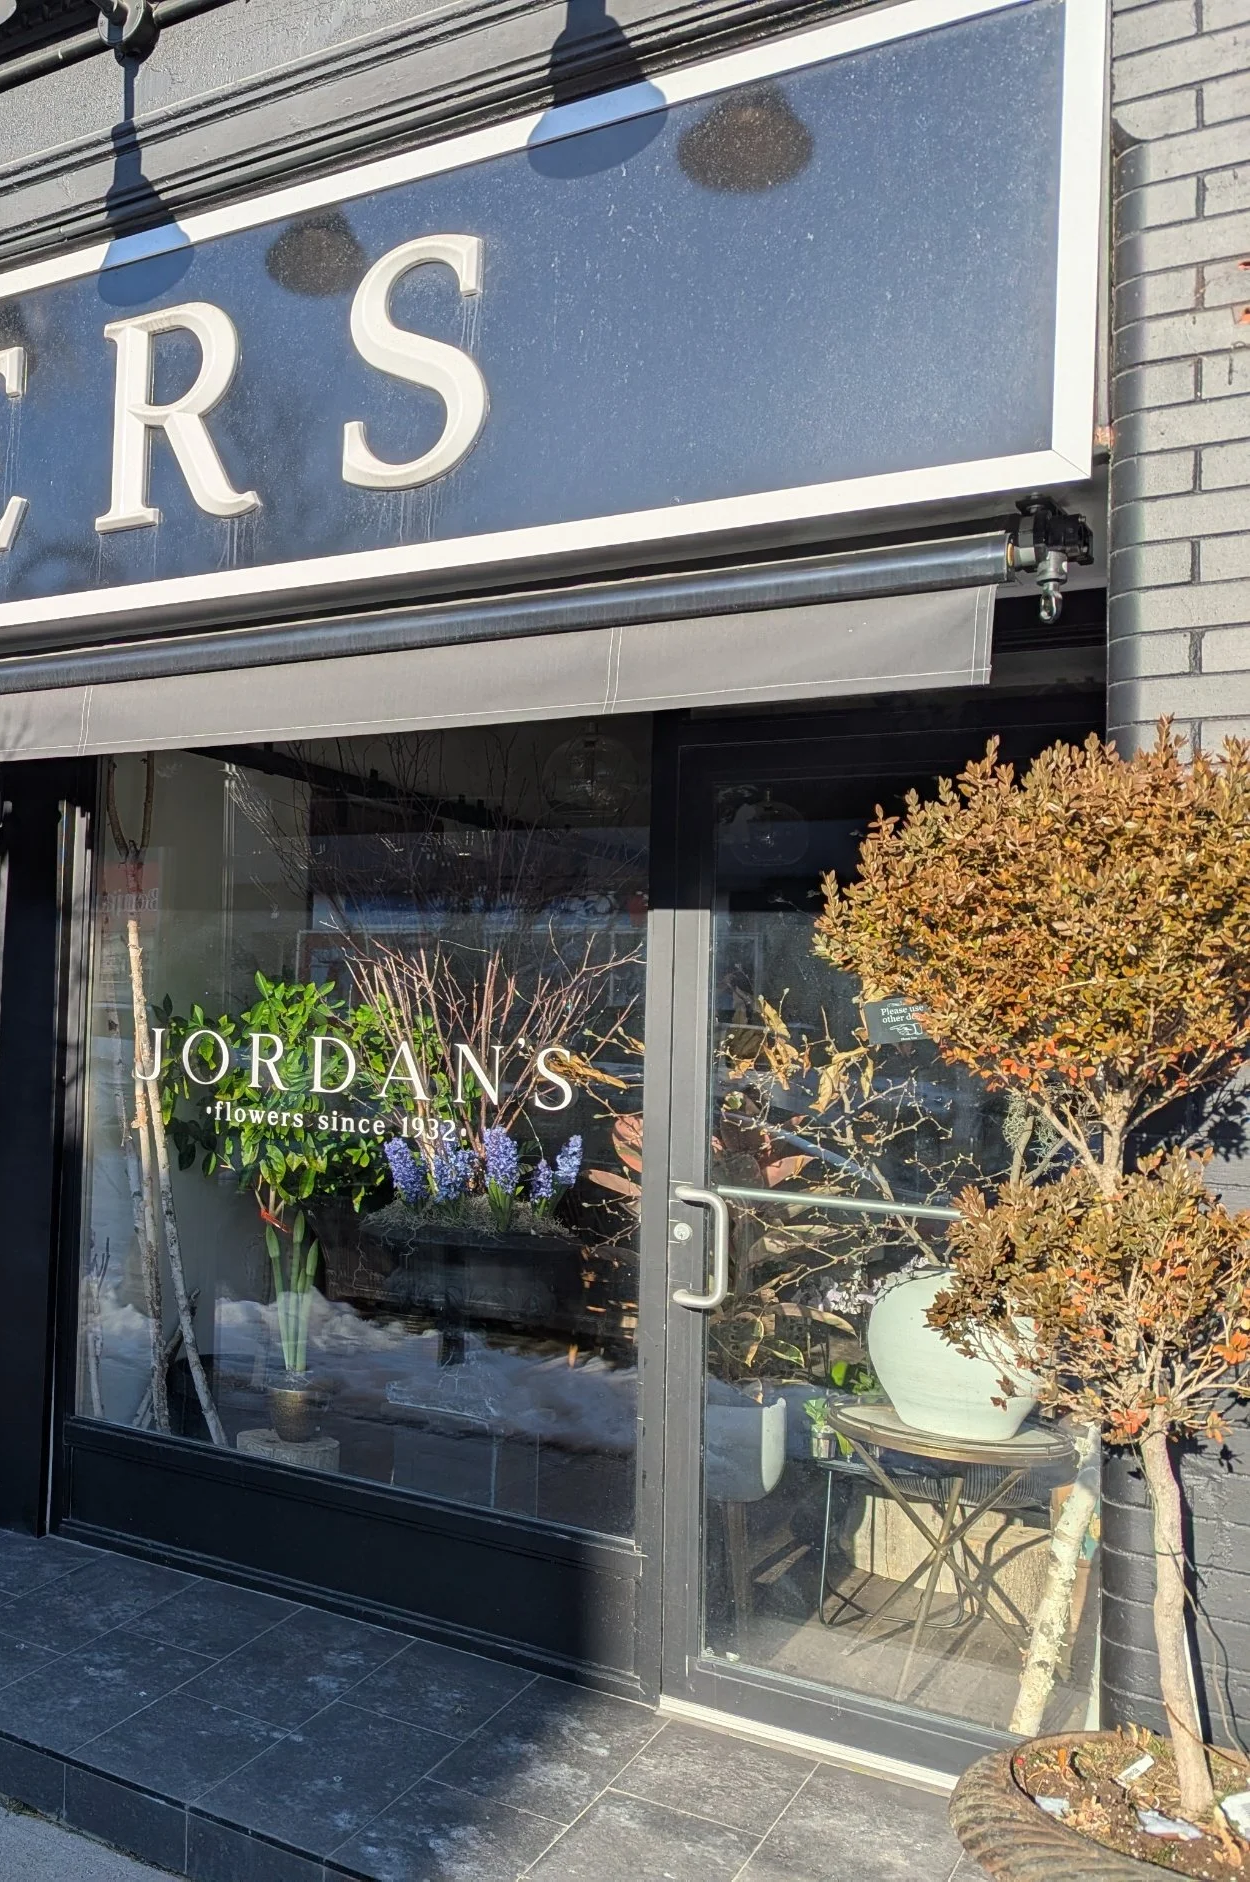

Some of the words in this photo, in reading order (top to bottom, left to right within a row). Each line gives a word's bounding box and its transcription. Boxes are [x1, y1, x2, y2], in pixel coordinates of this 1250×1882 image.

[880, 1006, 908, 1016] Please
[909, 1005, 924, 1013] use
[882, 1015, 905, 1023] other
[135, 1026, 574, 1112] JORDAN'S
[318, 1109, 386, 1136] since
